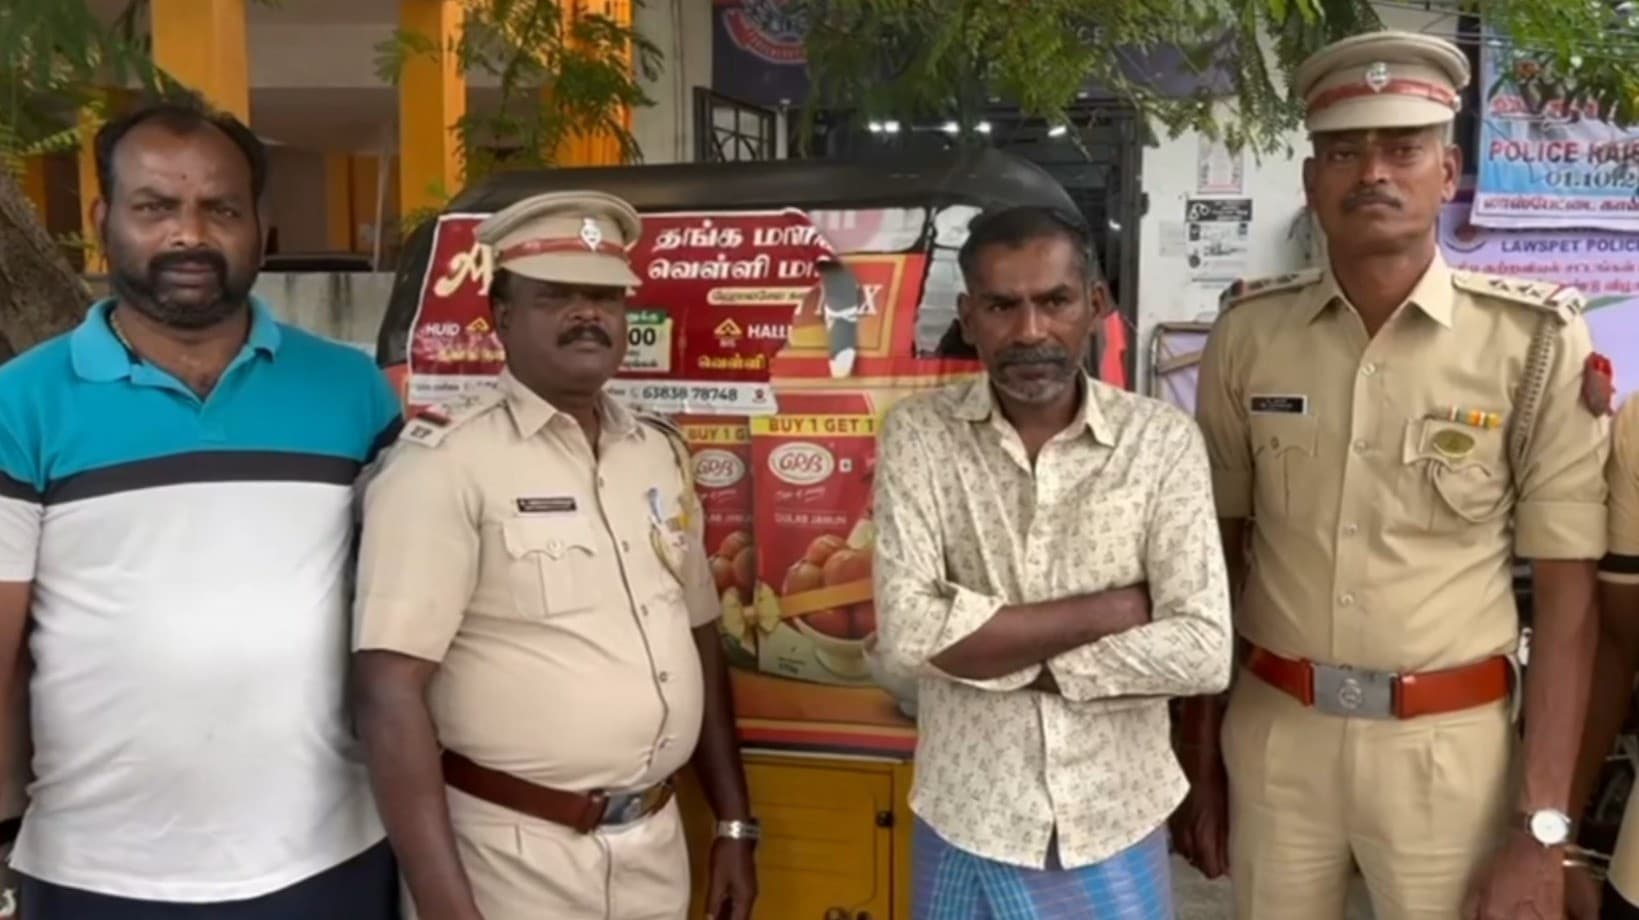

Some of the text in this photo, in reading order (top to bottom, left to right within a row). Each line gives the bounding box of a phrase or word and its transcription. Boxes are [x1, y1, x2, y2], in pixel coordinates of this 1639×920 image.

[1488, 140, 1579, 163] POLICE
[652, 218, 744, 252] தங்க
[1501, 239, 1581, 253] LAWSPET
[648, 253, 771, 280] வெள்ளி
[424, 323, 461, 337] HUID
[747, 324, 791, 339] HALL
[642, 387, 738, 401] 63838 78748
[769, 418, 806, 432] BUY
[809, 419, 818, 431] 1
[825, 418, 860, 432] GET
[723, 428, 731, 440] 1
